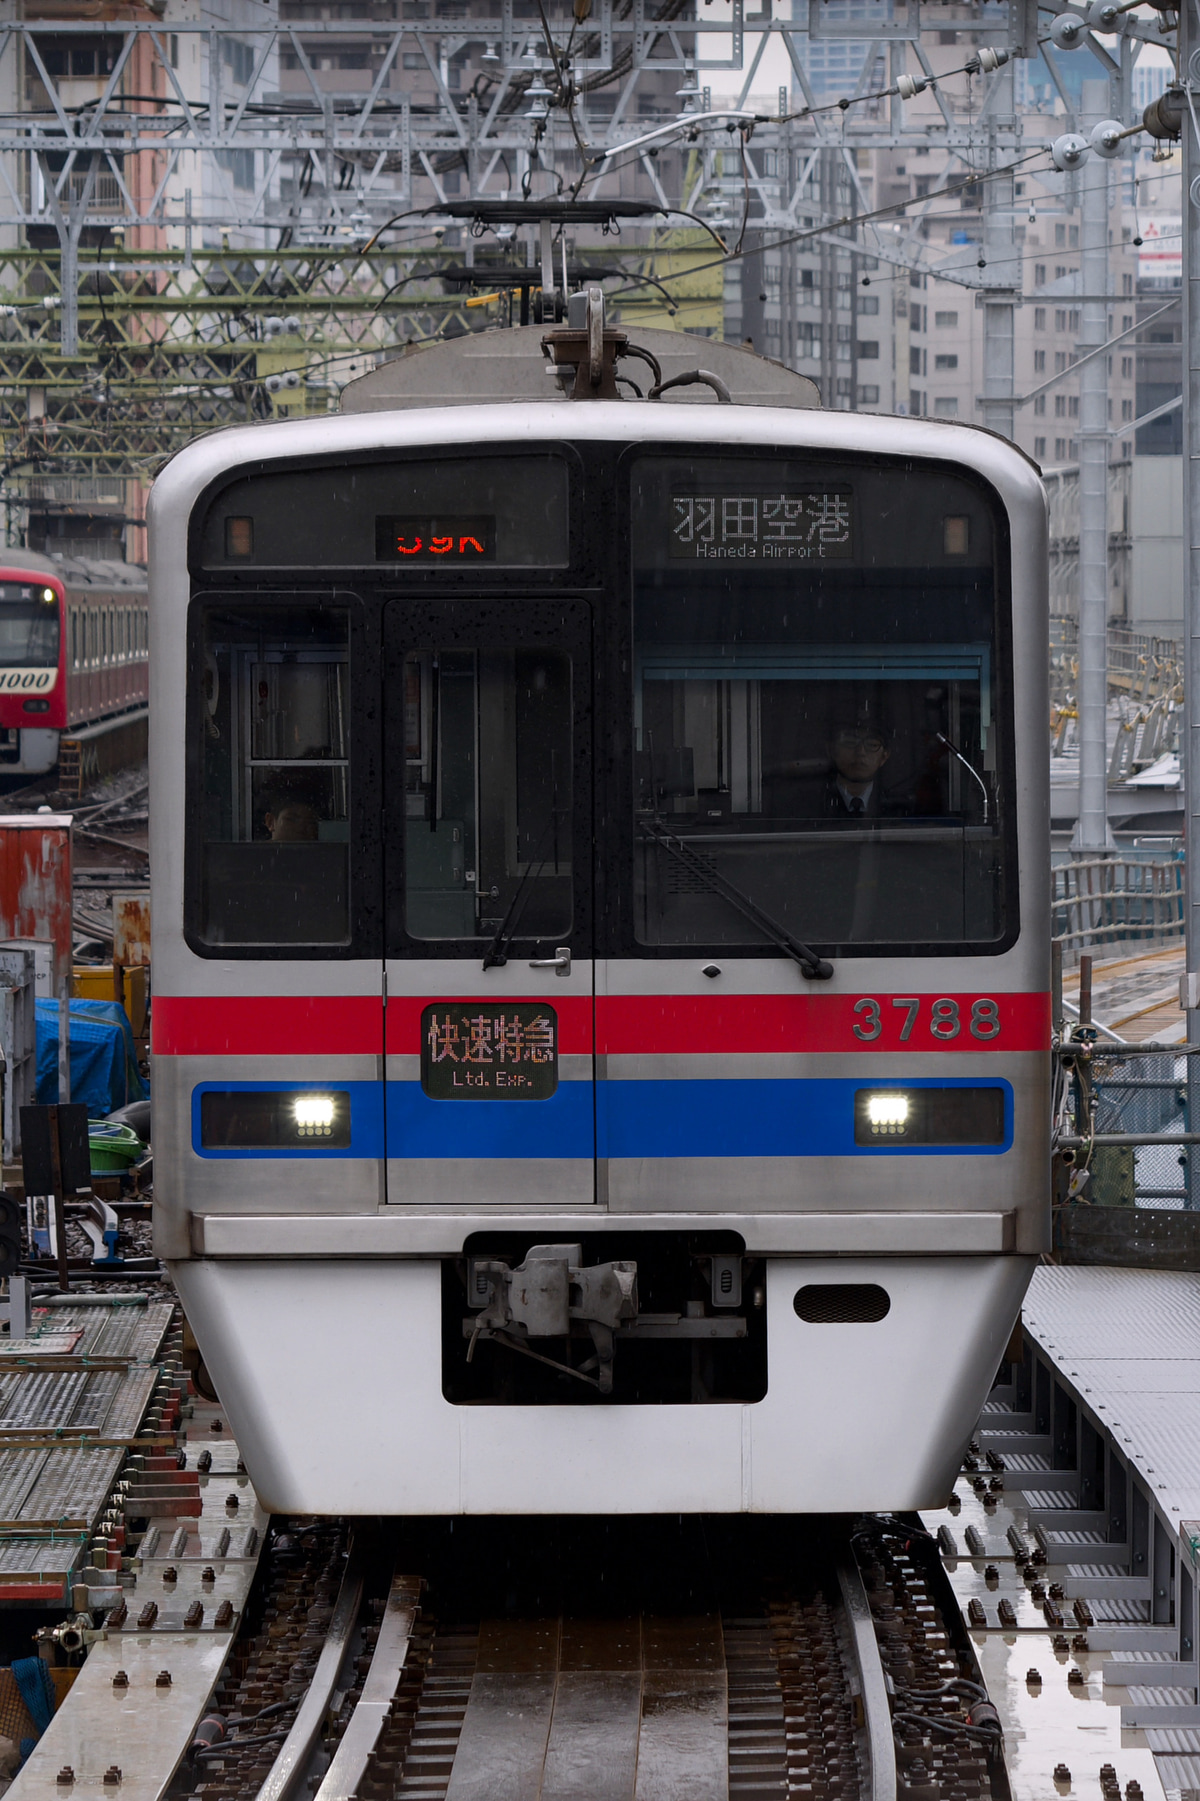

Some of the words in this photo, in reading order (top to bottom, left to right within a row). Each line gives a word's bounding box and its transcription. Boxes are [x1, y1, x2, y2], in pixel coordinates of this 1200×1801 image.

[673, 494, 849, 542] 羽田空港
[696, 543, 756, 558] Haneda
[762, 543, 826, 558] Airport
[427, 1014, 554, 1063] 快速特急
[852, 997, 1002, 1042] 3788
[453, 1071, 490, 1087] Ltd.
[496, 1071, 533, 1087] Exp.
